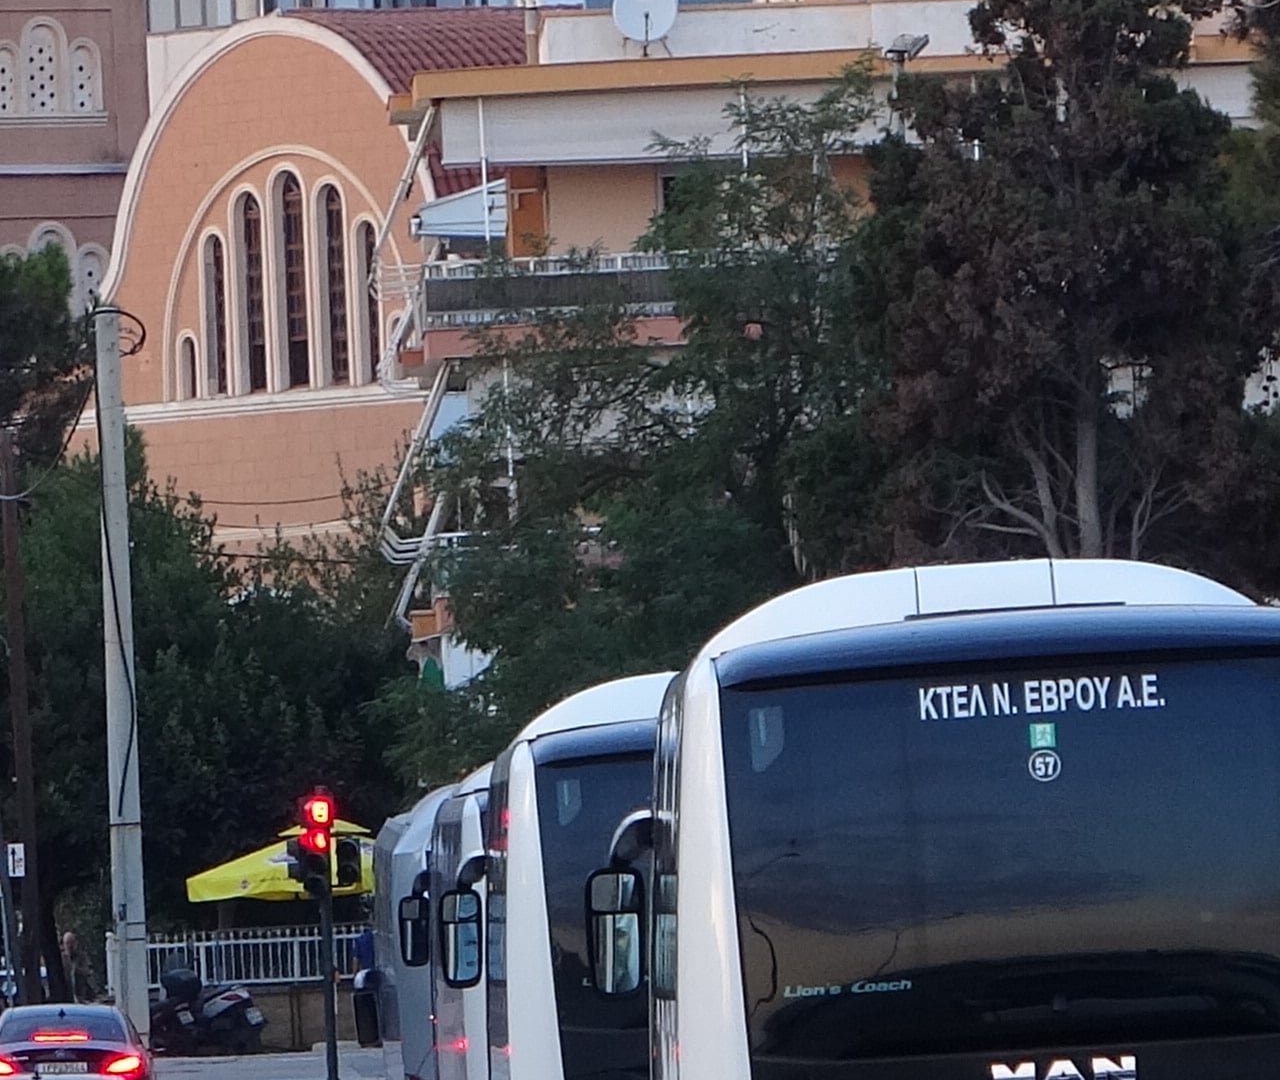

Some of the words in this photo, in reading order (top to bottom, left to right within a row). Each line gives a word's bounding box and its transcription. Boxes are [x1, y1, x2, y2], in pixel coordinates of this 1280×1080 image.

[919, 683, 988, 720] ΚΤΕΛ
[992, 682, 1018, 716] Ν.
[1023, 676, 1112, 714] ΕΒΡΟΥ
[1116, 674, 1166, 709] Α.Ε.
[1034, 756, 1056, 777] 57
[783, 983, 842, 999] Lion's
[850, 979, 913, 994] Coach
[991, 1055, 1137, 1080] MAN
